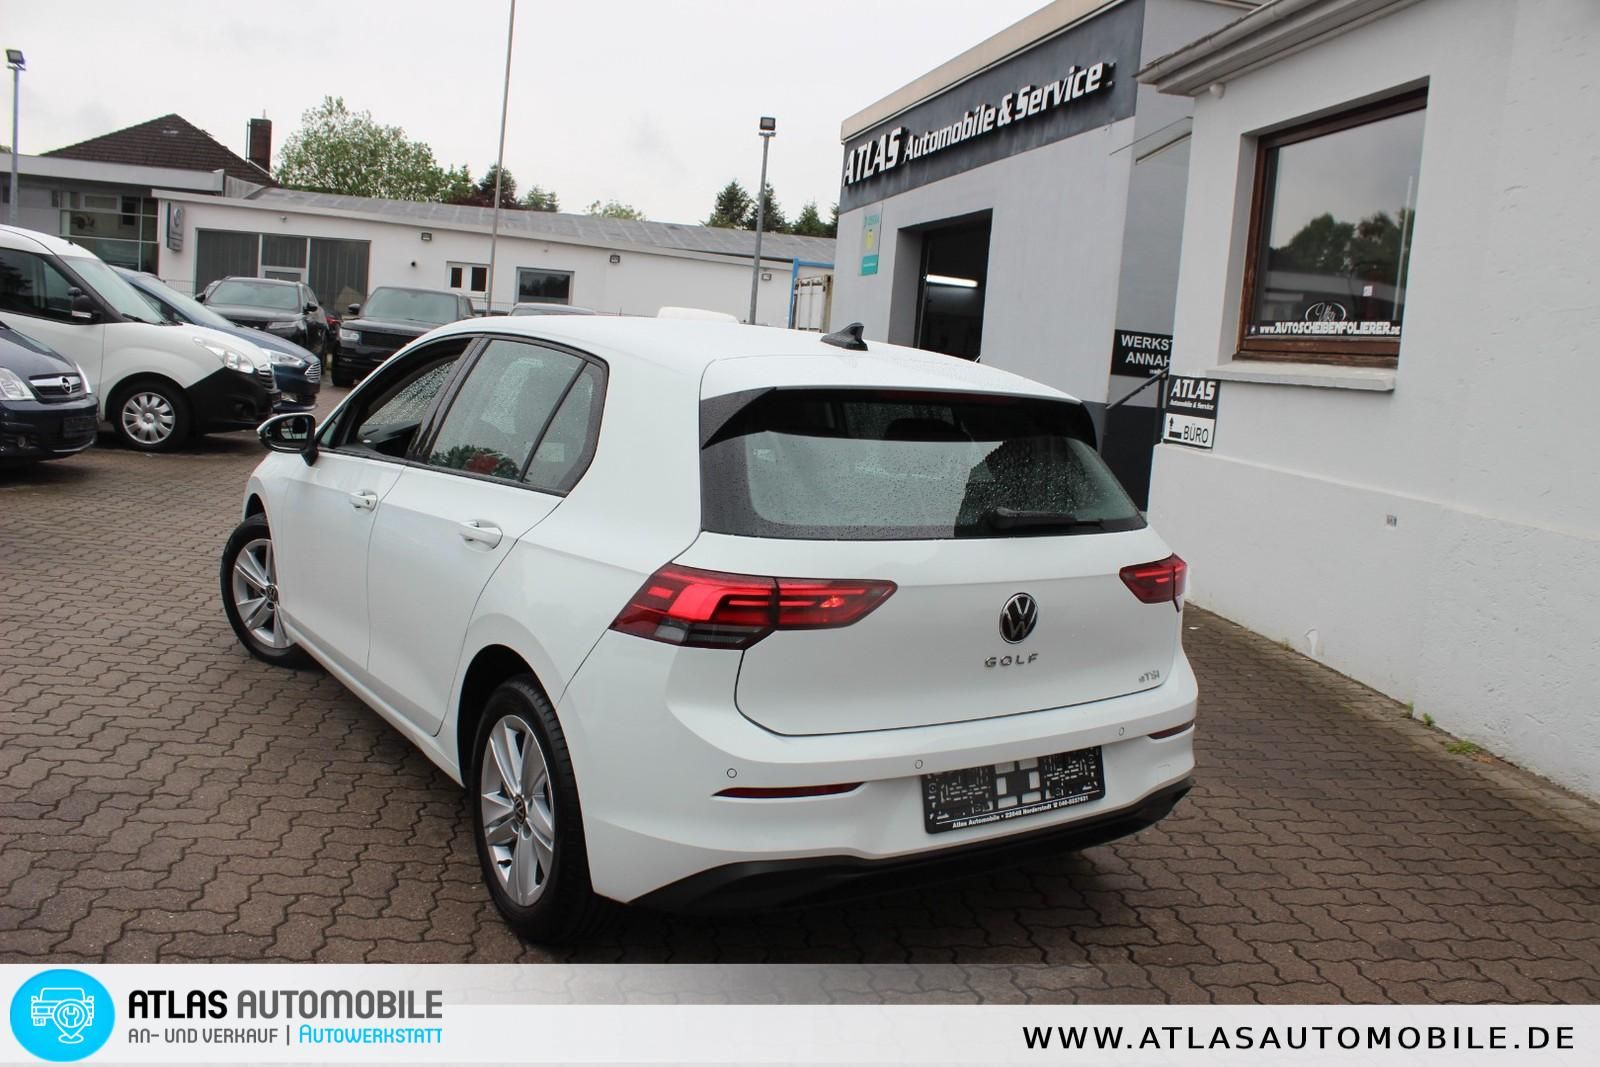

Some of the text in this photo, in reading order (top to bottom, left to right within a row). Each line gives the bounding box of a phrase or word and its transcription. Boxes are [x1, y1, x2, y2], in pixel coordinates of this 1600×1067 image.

[843, 63, 1104, 186] ATLAS Automobile & Service
[1121, 334, 1173, 351] WERKS
[1170, 379, 1216, 401] ATLAS
[1183, 423, 1209, 443] BÜRO
[984, 653, 1039, 668] GOLF
[952, 820, 968, 829] Atlas
[968, 815, 1000, 826] Automobile
